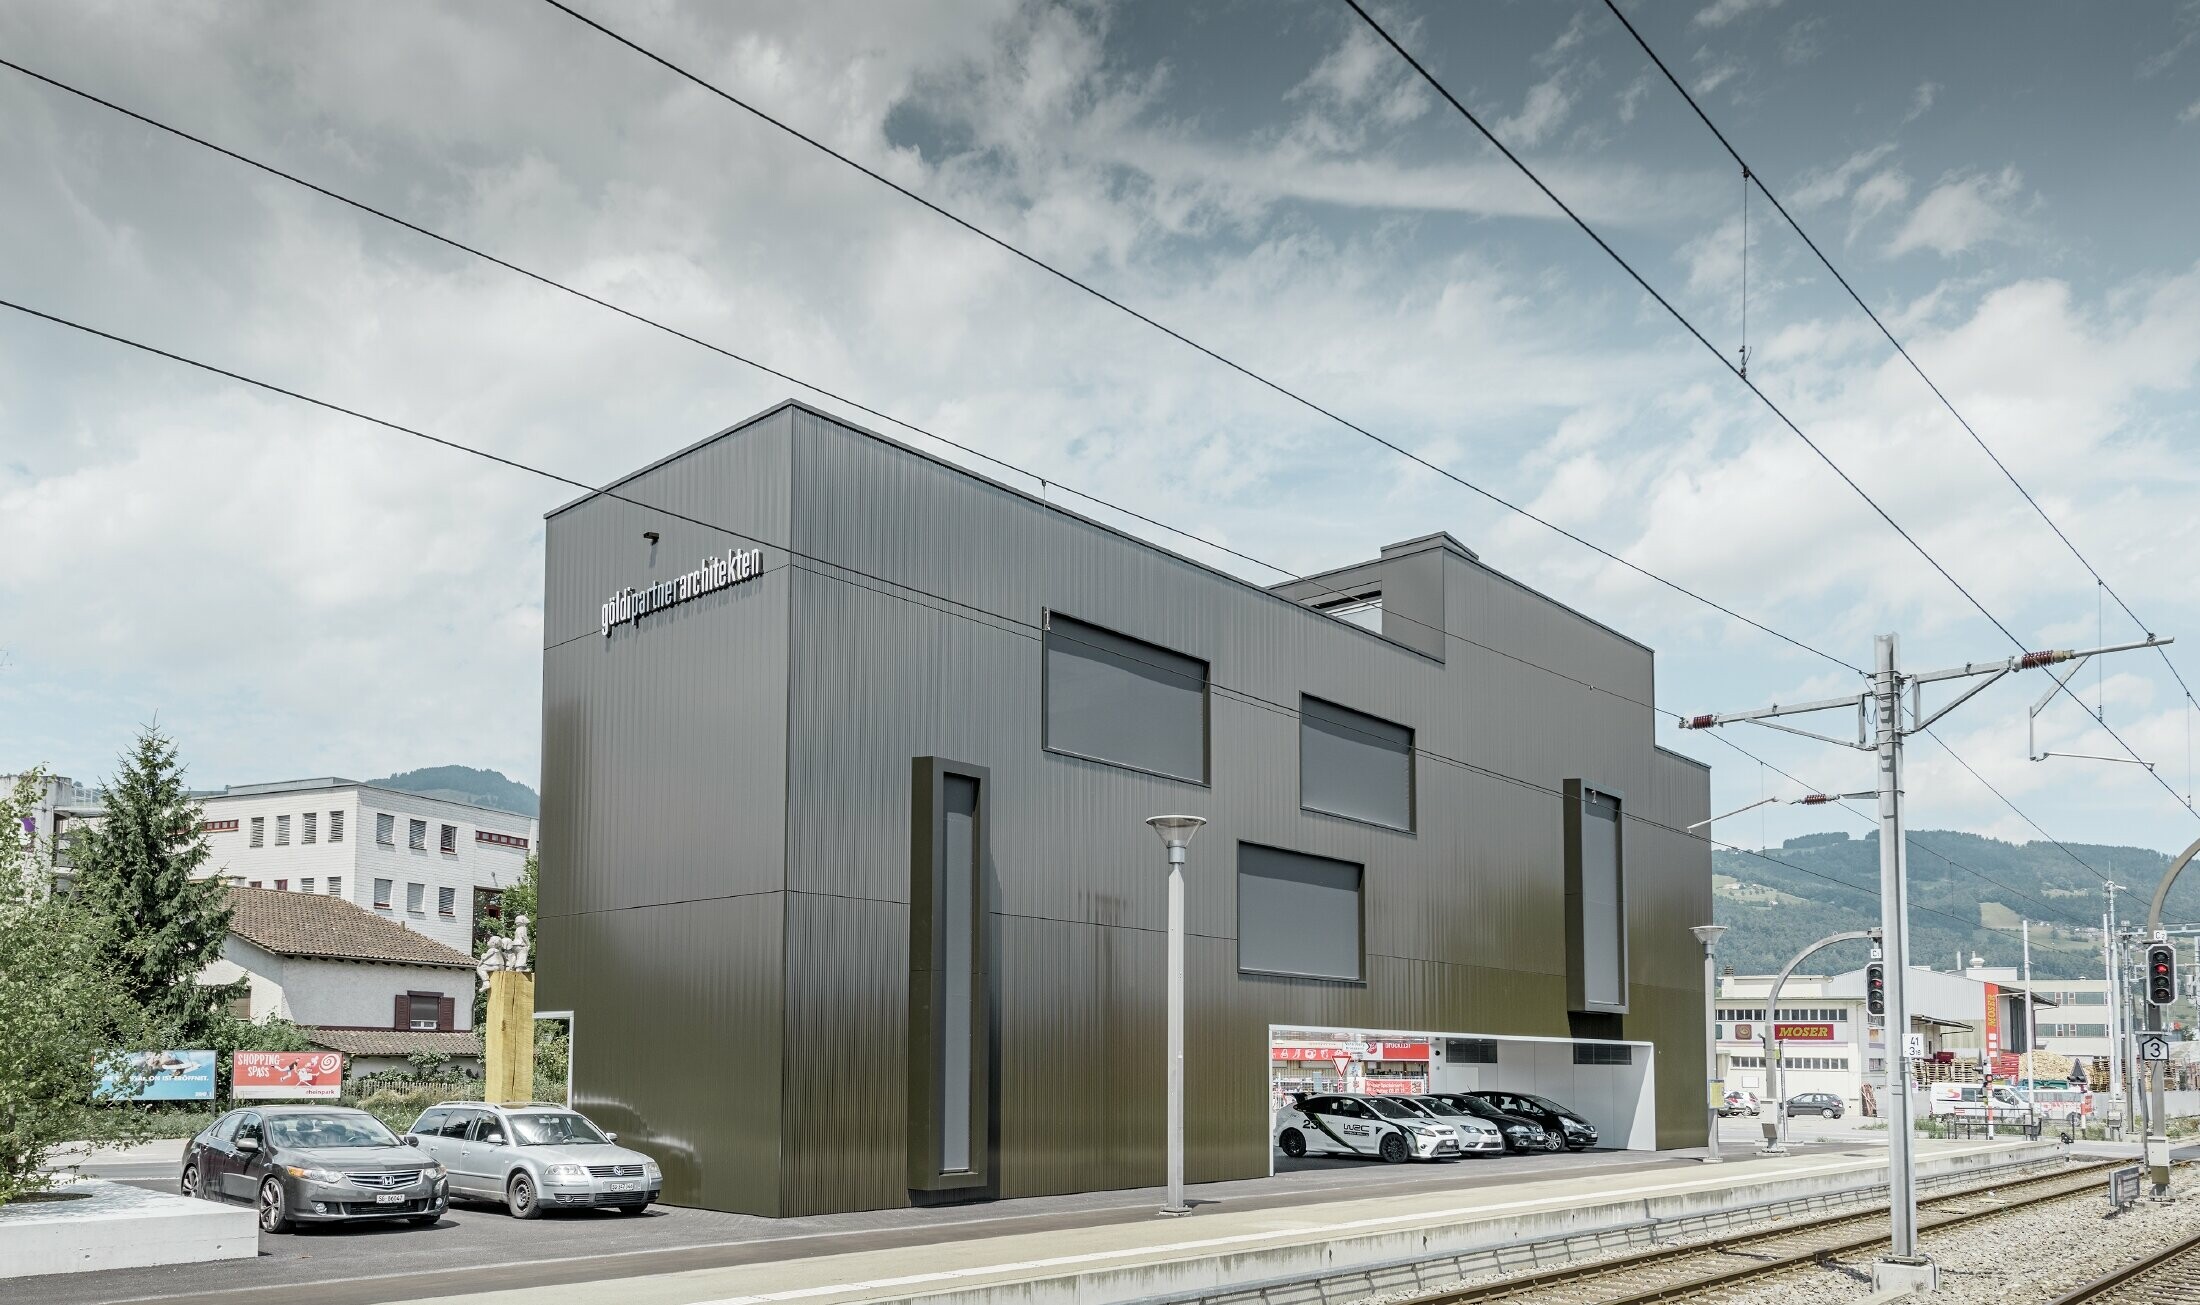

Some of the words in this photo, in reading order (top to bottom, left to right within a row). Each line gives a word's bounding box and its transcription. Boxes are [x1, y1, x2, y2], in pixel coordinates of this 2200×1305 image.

[1987, 994, 1997, 1027] MOSER
[1779, 1027, 1828, 1037] MOSER
[1910, 1036, 1919, 1046] 41
[2150, 1042, 2161, 1058] 3
[247, 1065, 270, 1078] SPASS
